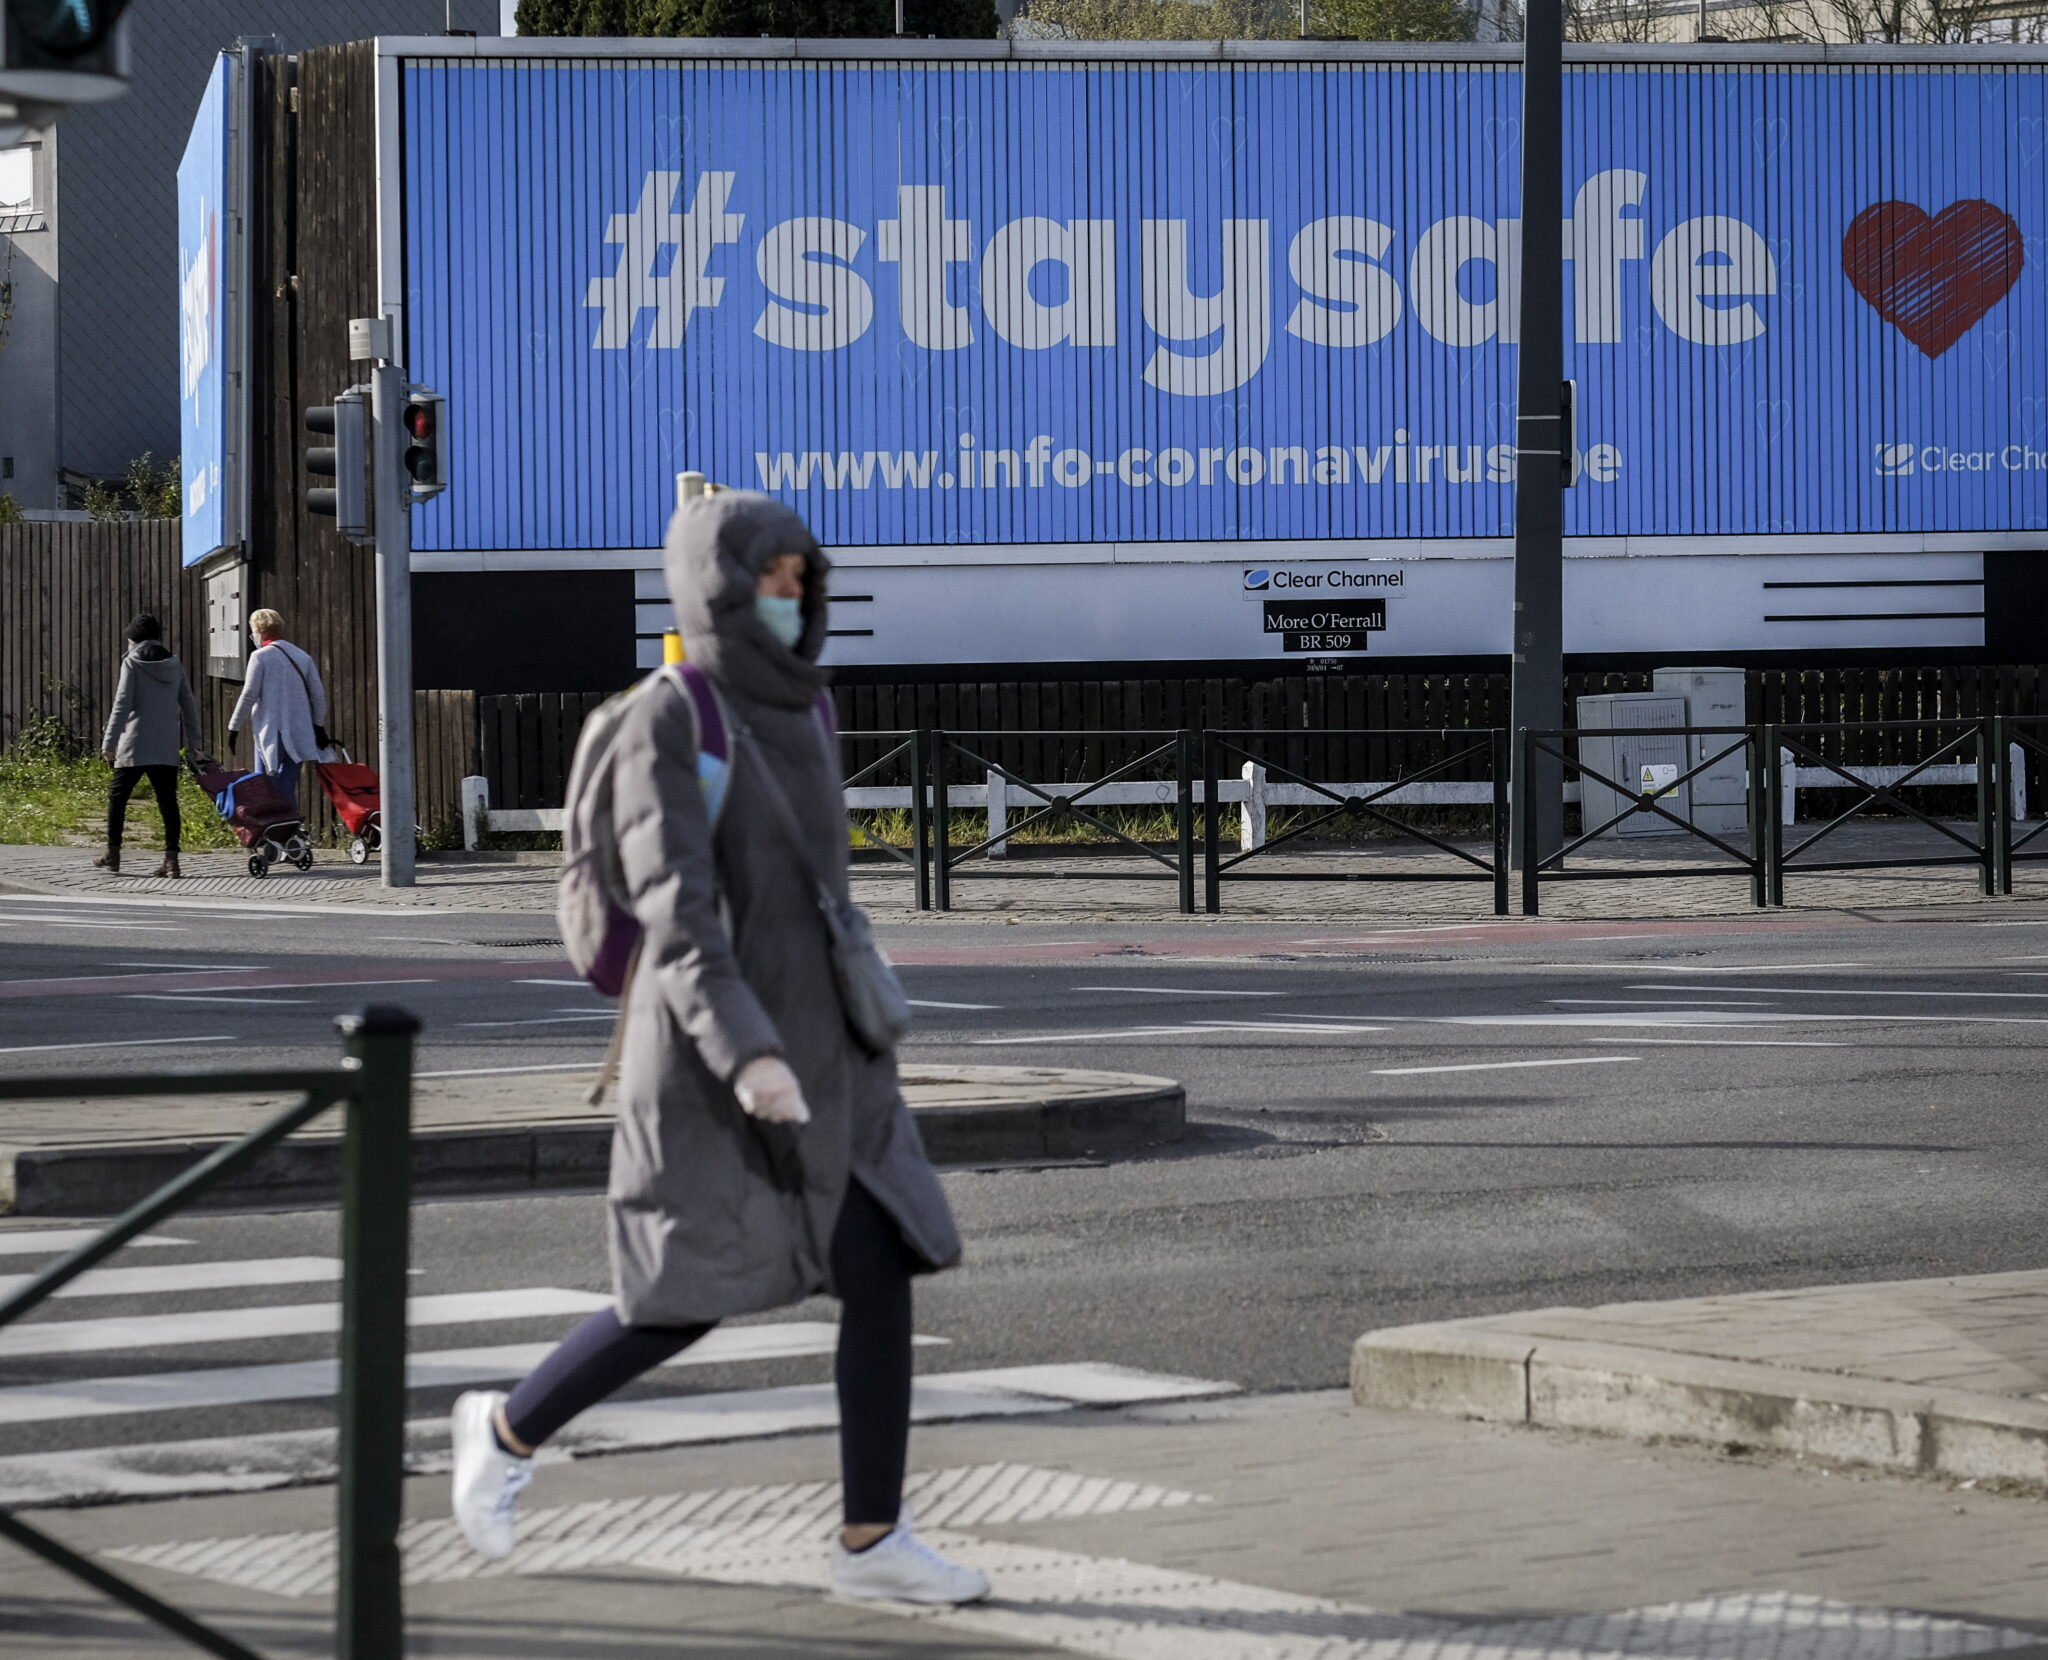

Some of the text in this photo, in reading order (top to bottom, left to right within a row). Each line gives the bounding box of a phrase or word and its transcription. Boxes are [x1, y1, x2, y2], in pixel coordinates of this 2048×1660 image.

[583, 168, 1777, 397] #staysafe
[755, 428, 1623, 491] www.info-coronaviruse
[1921, 445, 1995, 472] Clear
[1273, 569, 1404, 588] Clear Channel
[1266, 612, 1382, 630] More O'Ferrall
[1300, 634, 1351, 649] BR 509
